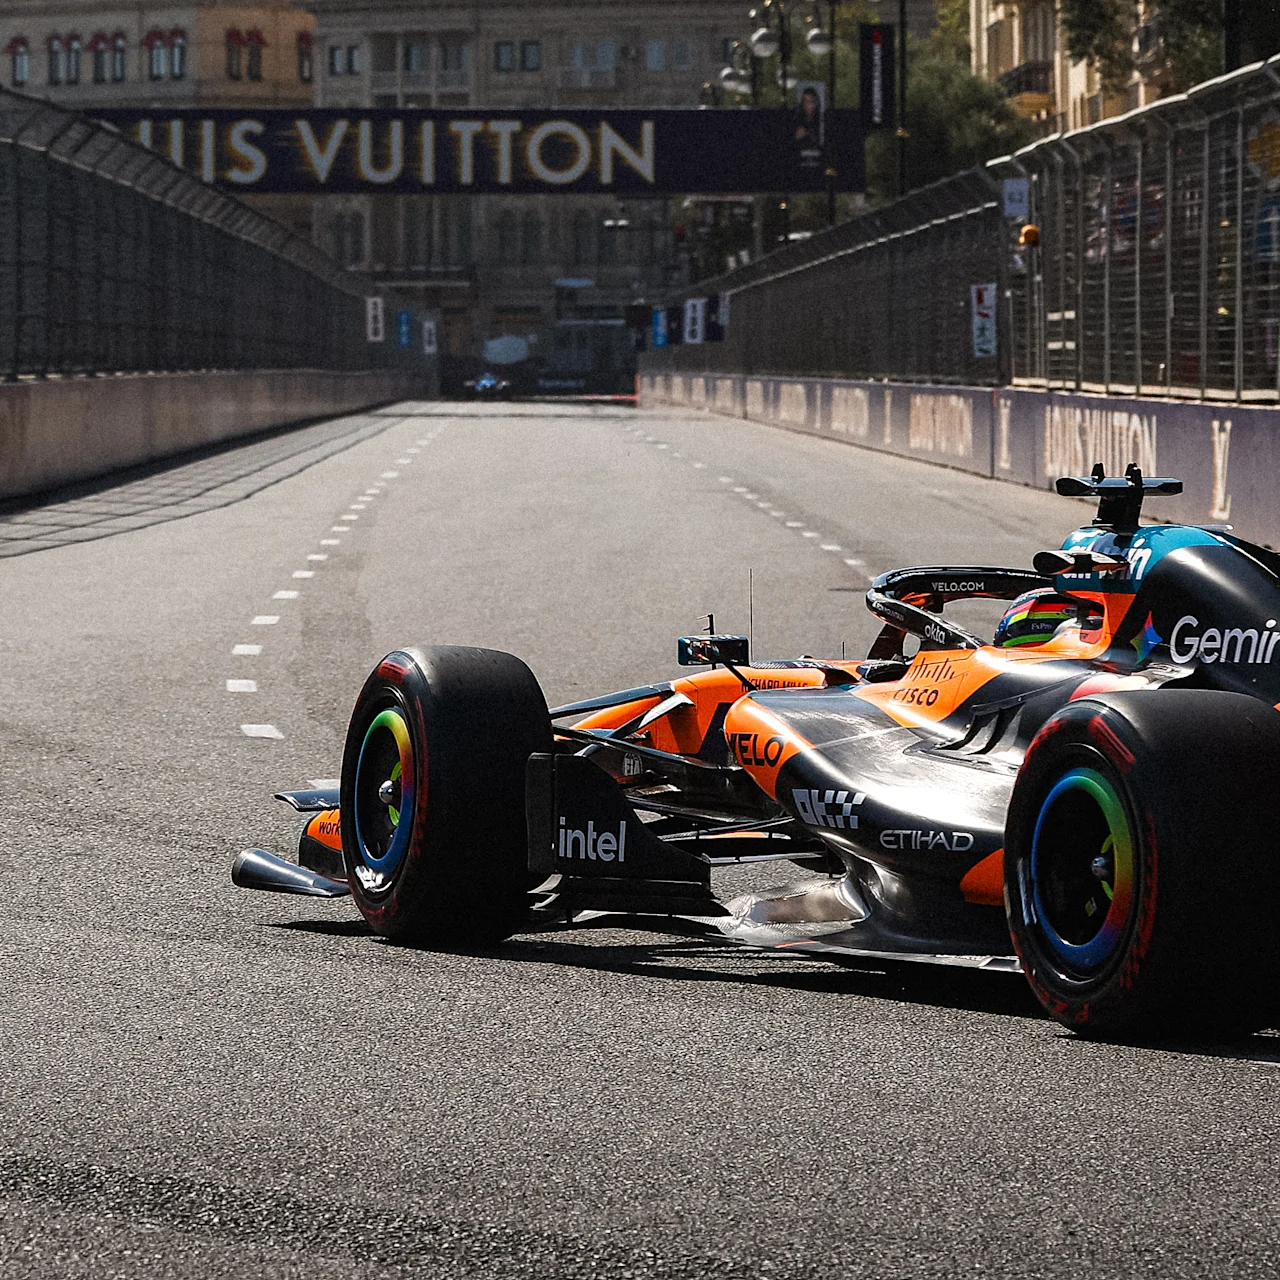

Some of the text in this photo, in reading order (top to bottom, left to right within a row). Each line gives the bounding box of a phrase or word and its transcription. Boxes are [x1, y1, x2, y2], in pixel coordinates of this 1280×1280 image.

[294, 118, 655, 186] VUITTON
[931, 581, 985, 592] VELO.COM
[924, 623, 946, 644] okta
[892, 687, 939, 707] CISCO
[726, 732, 785, 767] VELO
[791, 788, 868, 830] OKX
[319, 821, 342, 835] work
[558, 816, 627, 862] intel
[879, 829, 976, 852] ETIHAD
